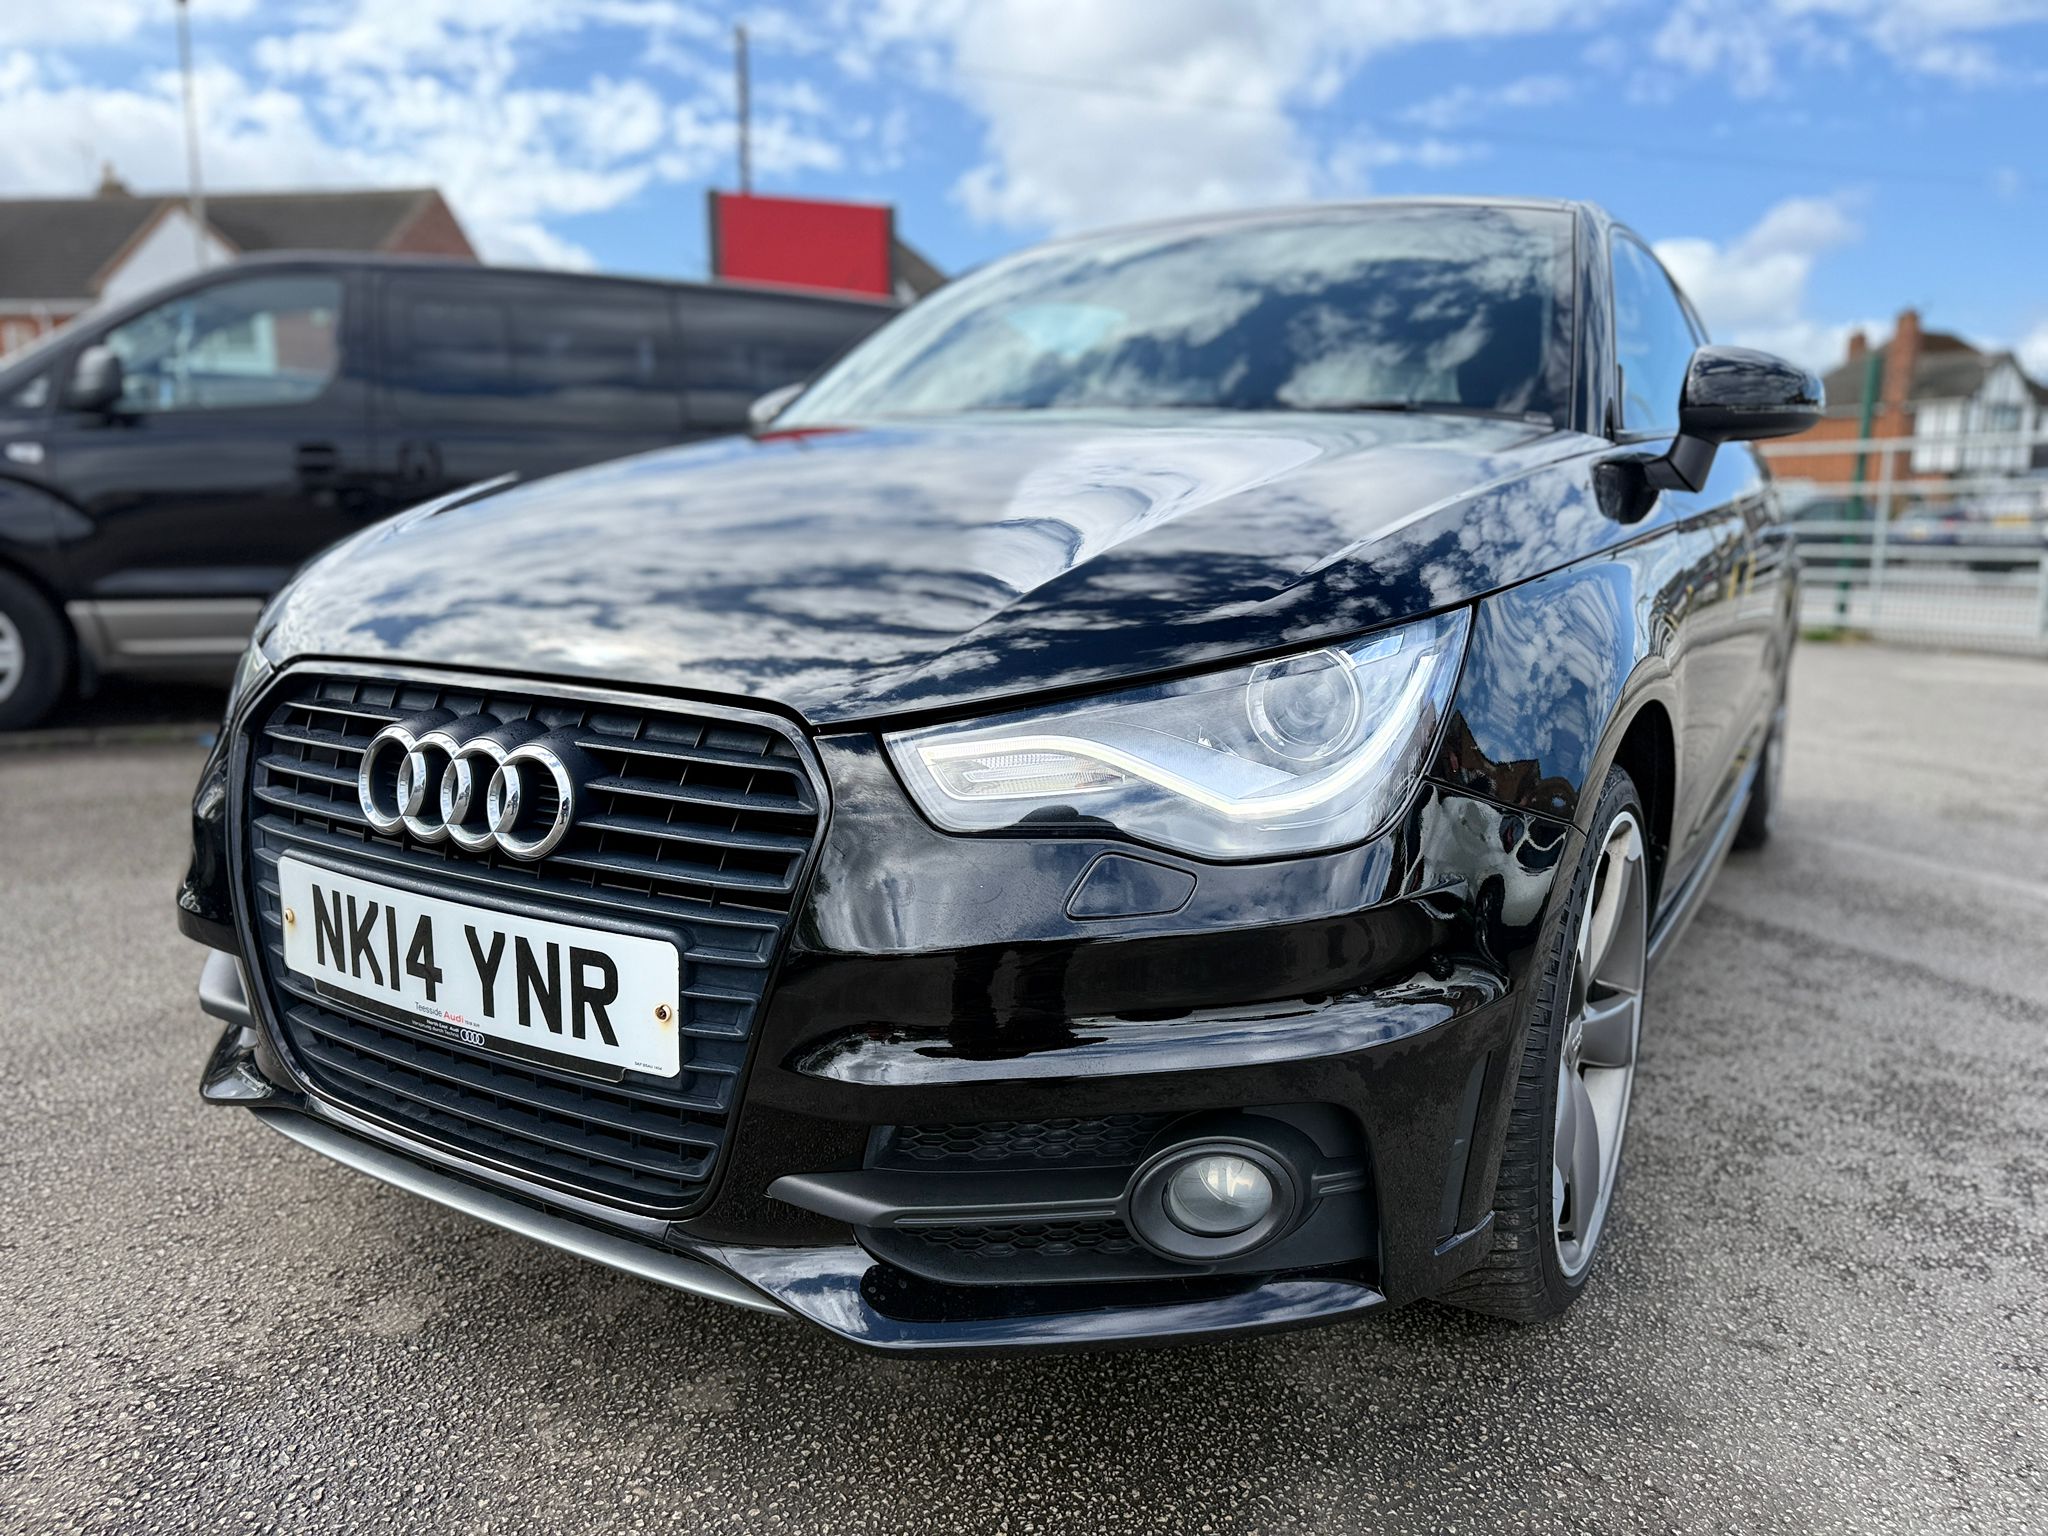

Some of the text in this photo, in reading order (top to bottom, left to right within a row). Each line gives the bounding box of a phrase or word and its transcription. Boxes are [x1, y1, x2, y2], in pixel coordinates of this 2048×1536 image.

[311, 883, 620, 1047] NK14 YNR
[415, 1001, 464, 1023] Teesside Audi
